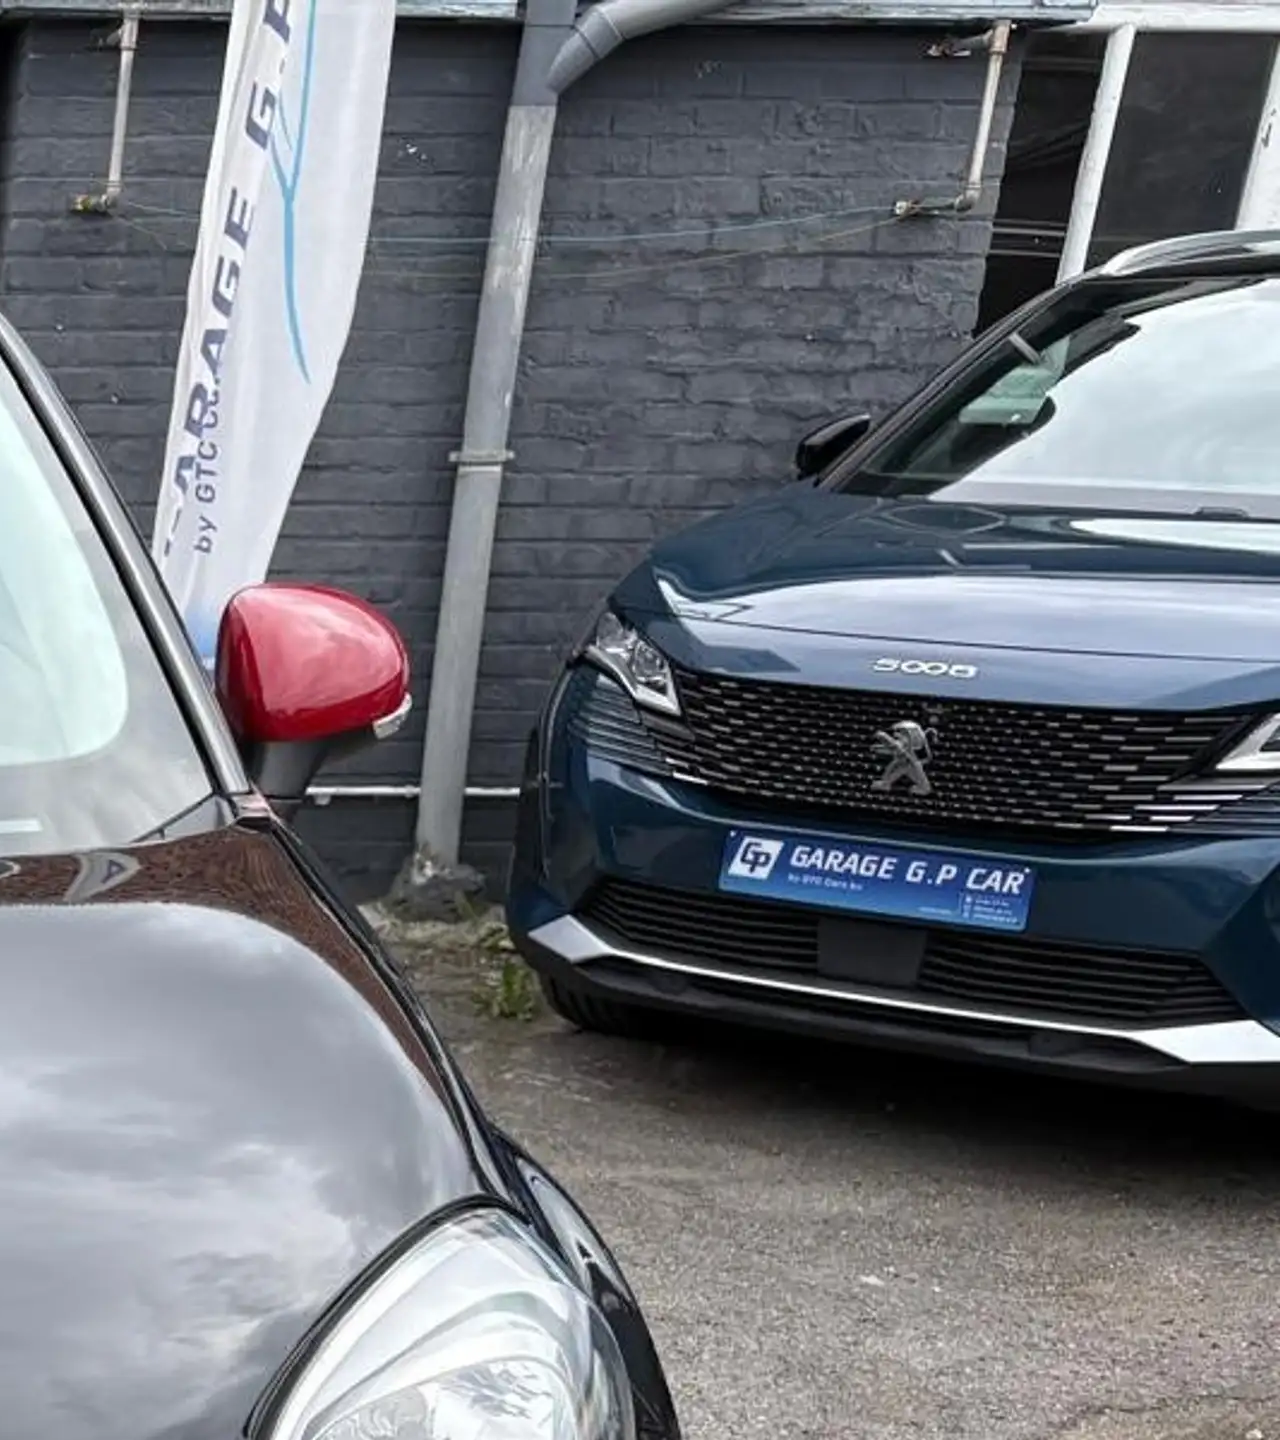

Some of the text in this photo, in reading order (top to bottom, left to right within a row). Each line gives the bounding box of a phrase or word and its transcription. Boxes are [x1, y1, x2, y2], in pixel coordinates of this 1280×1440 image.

[194, 439, 220, 503] GTC
[193, 514, 219, 553] by
[789, 845, 1025, 895] GARAGE G.P CAR
